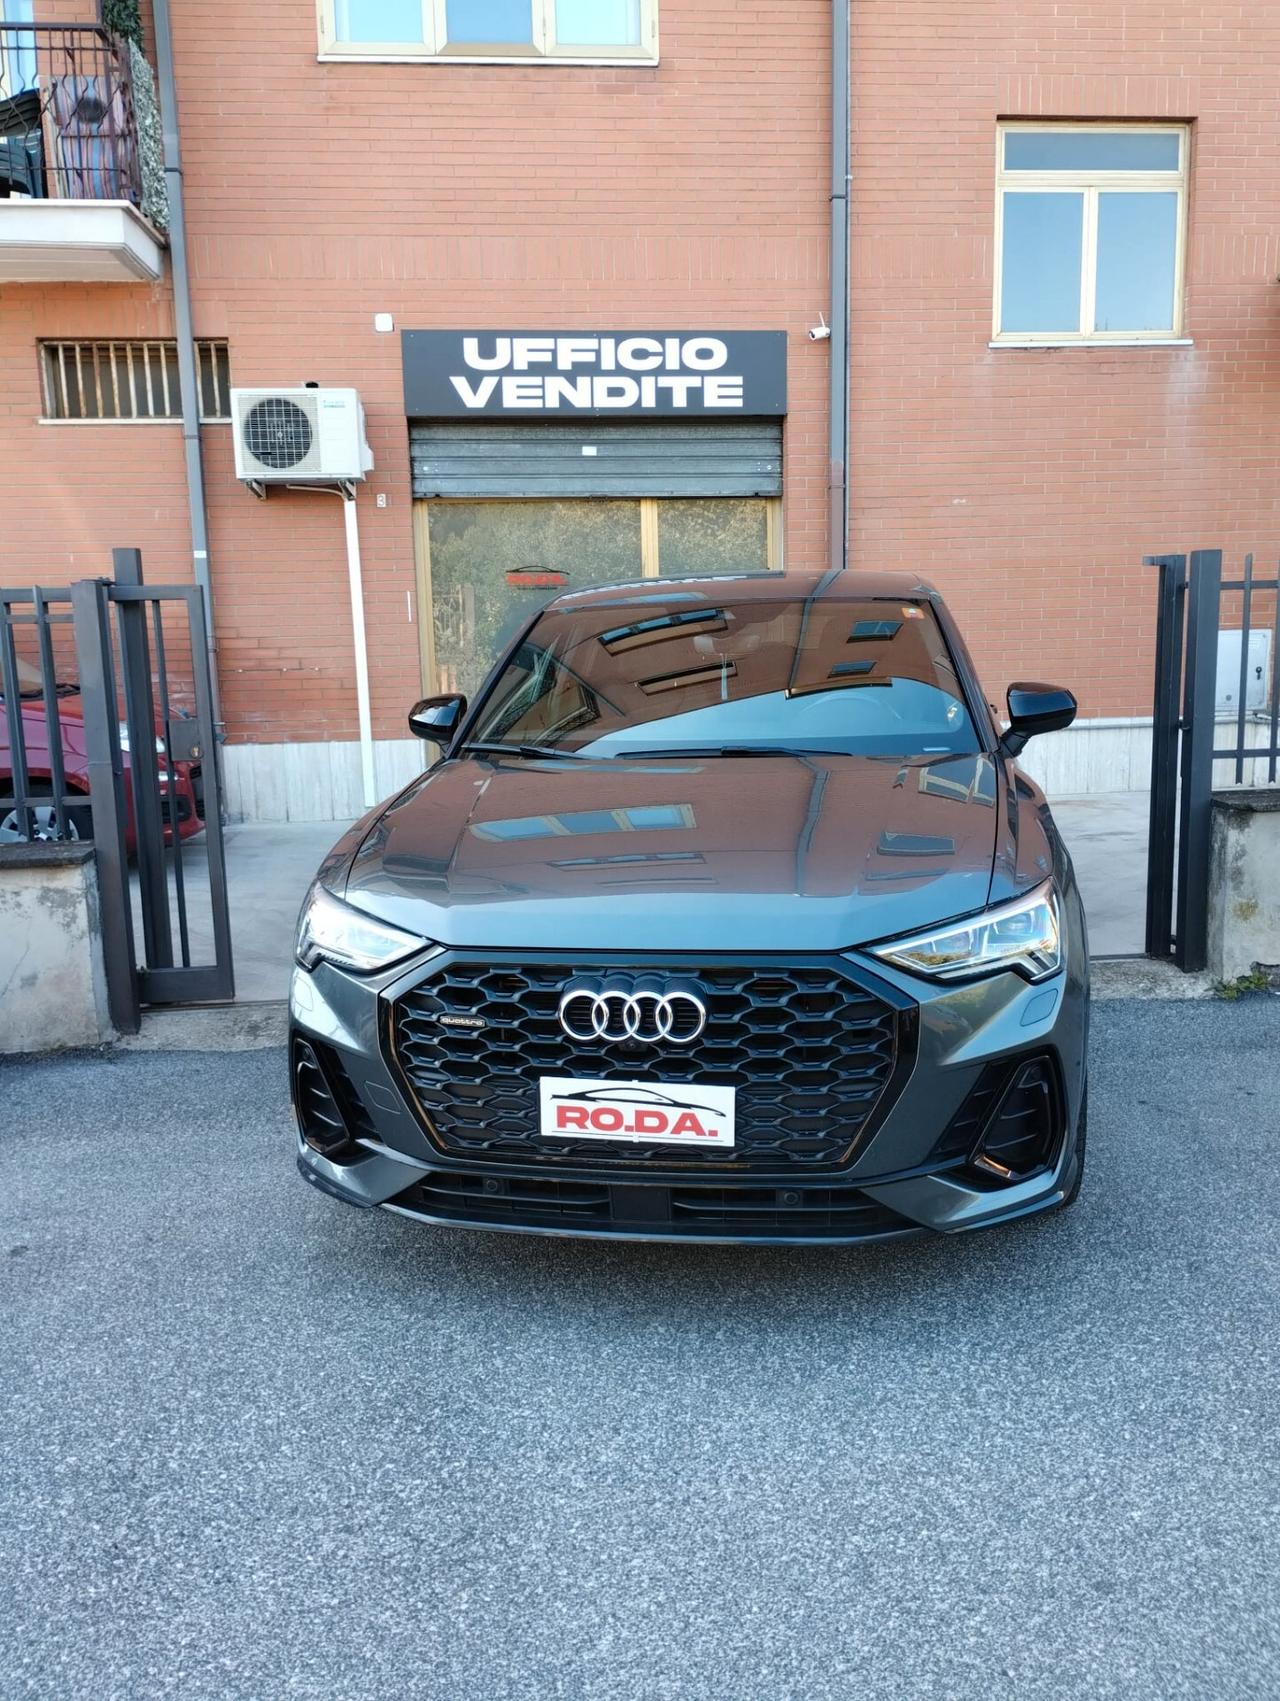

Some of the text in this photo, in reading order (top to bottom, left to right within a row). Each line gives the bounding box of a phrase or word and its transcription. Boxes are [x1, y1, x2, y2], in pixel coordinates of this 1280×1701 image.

[463, 338, 728, 371] UFFICIO
[449, 376, 743, 408] VENDITE
[441, 1016, 484, 1026] quattro
[556, 1105, 718, 1137] RO.DA.
